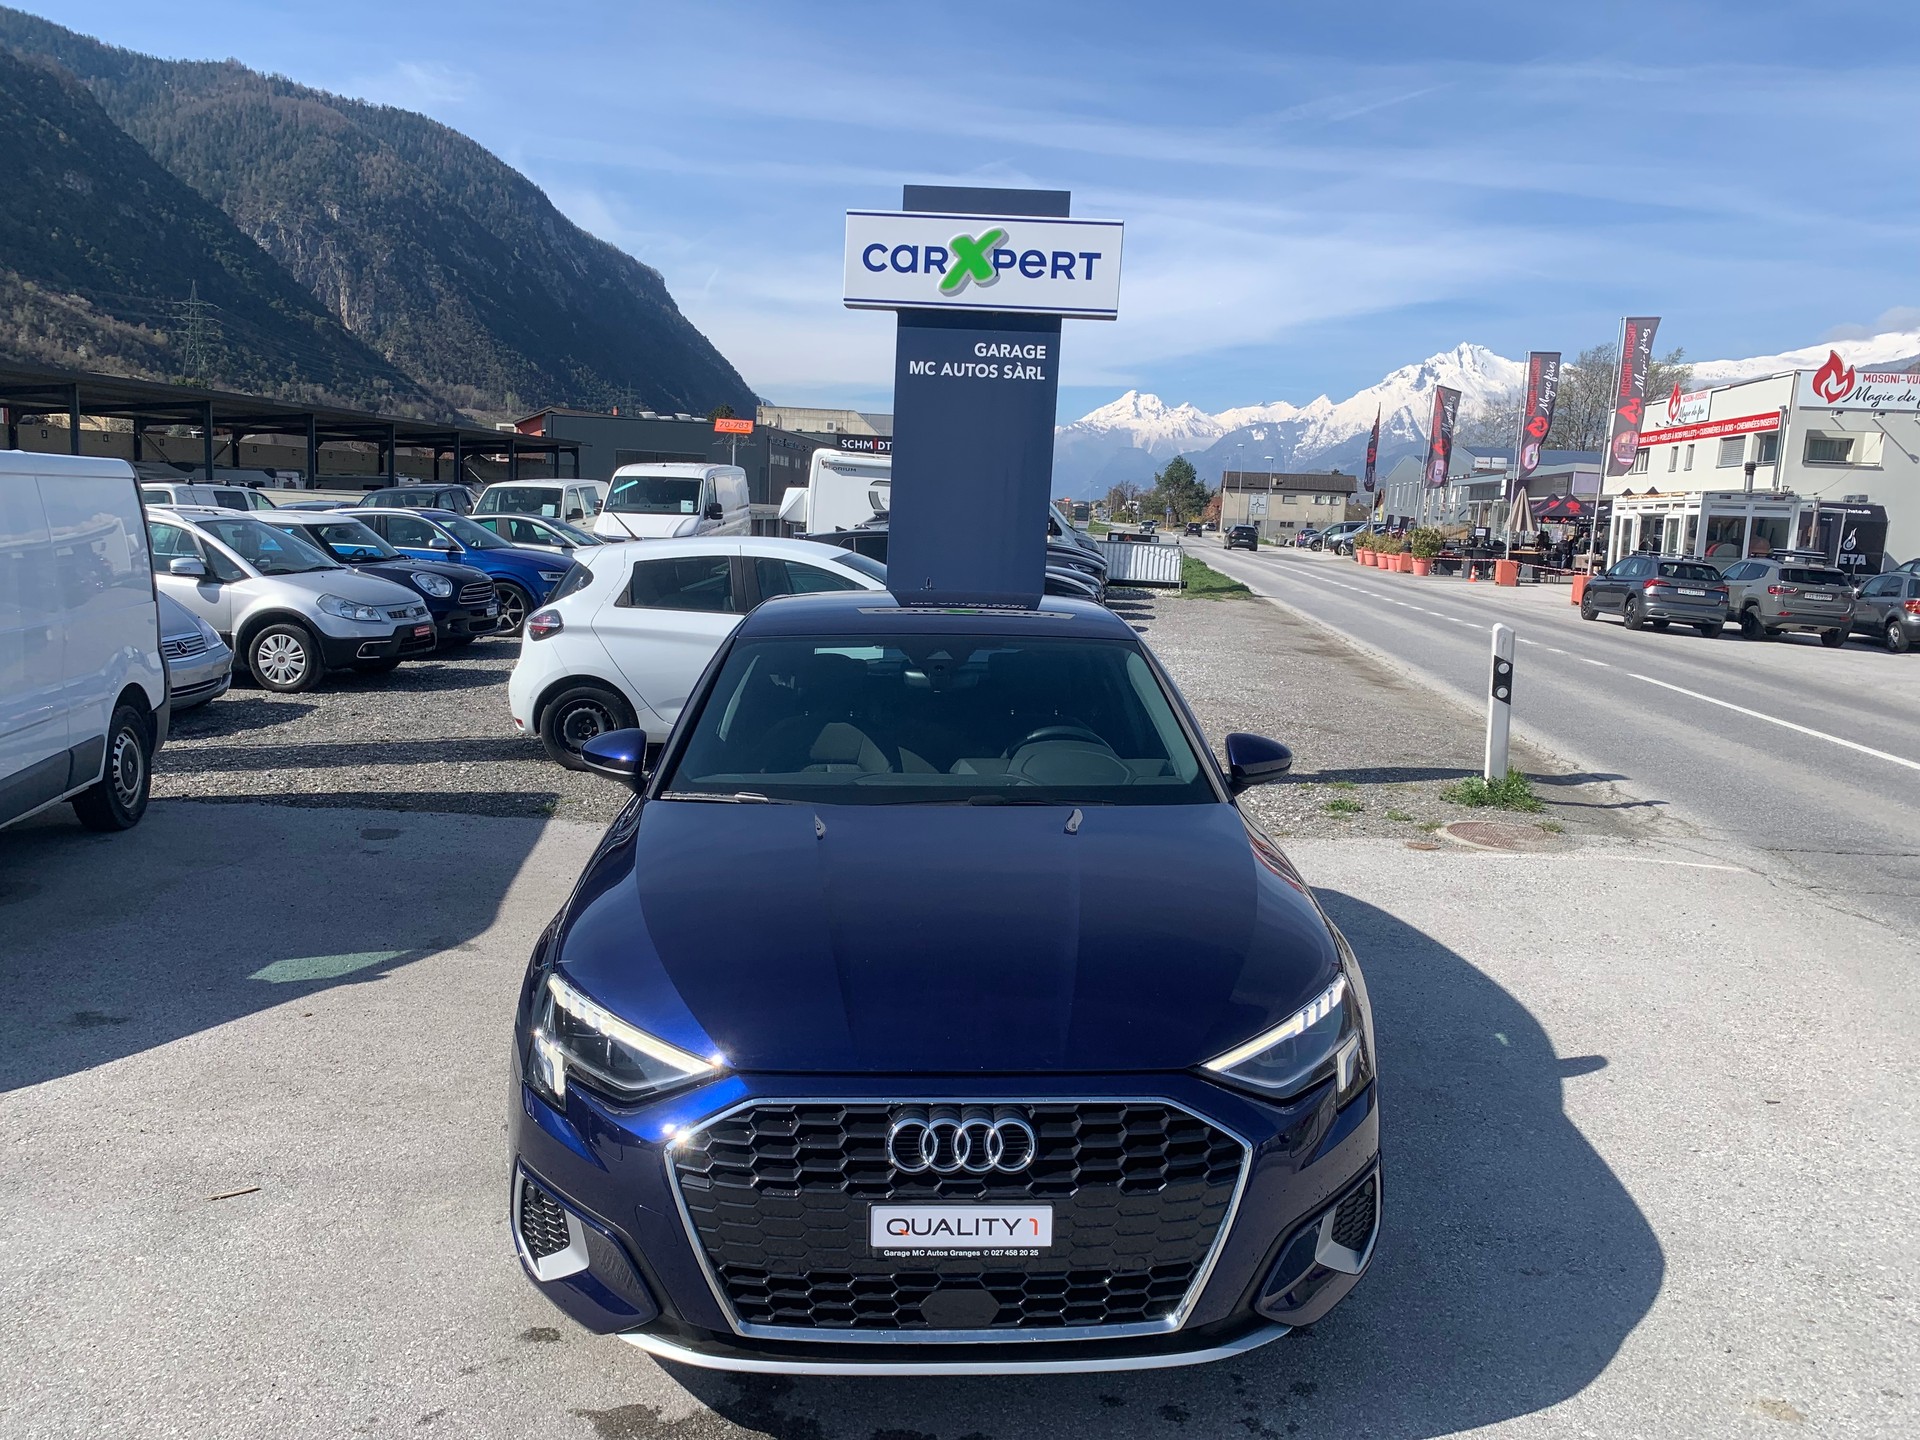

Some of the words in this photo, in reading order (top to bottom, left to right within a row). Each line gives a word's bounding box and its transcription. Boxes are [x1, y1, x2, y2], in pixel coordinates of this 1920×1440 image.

[974, 342, 1046, 359] GARAGE
[909, 361, 936, 377] MC
[940, 363, 999, 379] AUTOS
[1003, 362, 1046, 380] SÀRL
[1842, 385, 1895, 408] Magie
[1897, 389, 1917, 402] du
[841, 438, 892, 450] SCHMIDT
[1839, 553, 1867, 565] ETA
[886, 1218, 1022, 1236] QUALITY
[1029, 1218, 1038, 1236] 1
